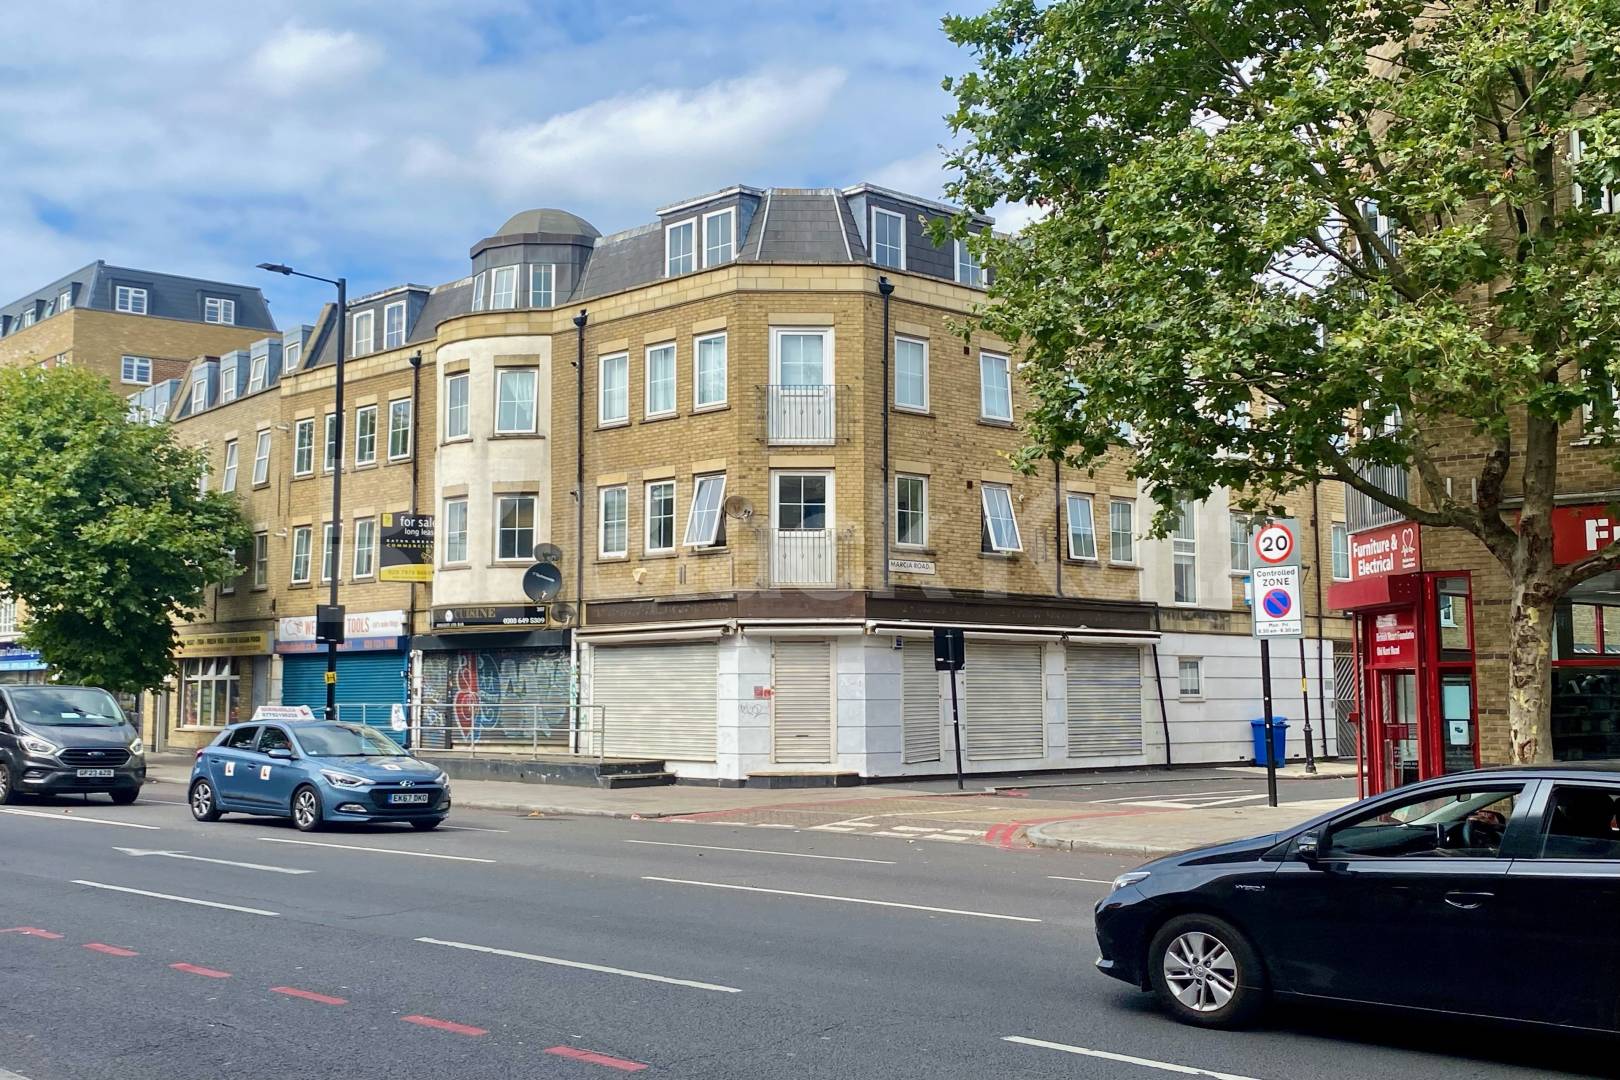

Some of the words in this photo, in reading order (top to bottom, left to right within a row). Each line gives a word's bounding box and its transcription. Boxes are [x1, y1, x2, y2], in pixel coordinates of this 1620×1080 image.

[400, 515, 416, 527] for
[404, 528, 420, 536] long
[1262, 535, 1288, 552] 20
[1352, 538, 1390, 558] Furniture
[1391, 533, 1398, 551] &
[890, 561, 913, 569] MARCIA
[1358, 552, 1394, 577] Electrical
[1256, 568, 1296, 578] Controlled
[1262, 578, 1291, 587] ZONE
[453, 607, 496, 619] CUISINE
[347, 617, 370, 633] TOOLS
[393, 794, 412, 802] EK67
